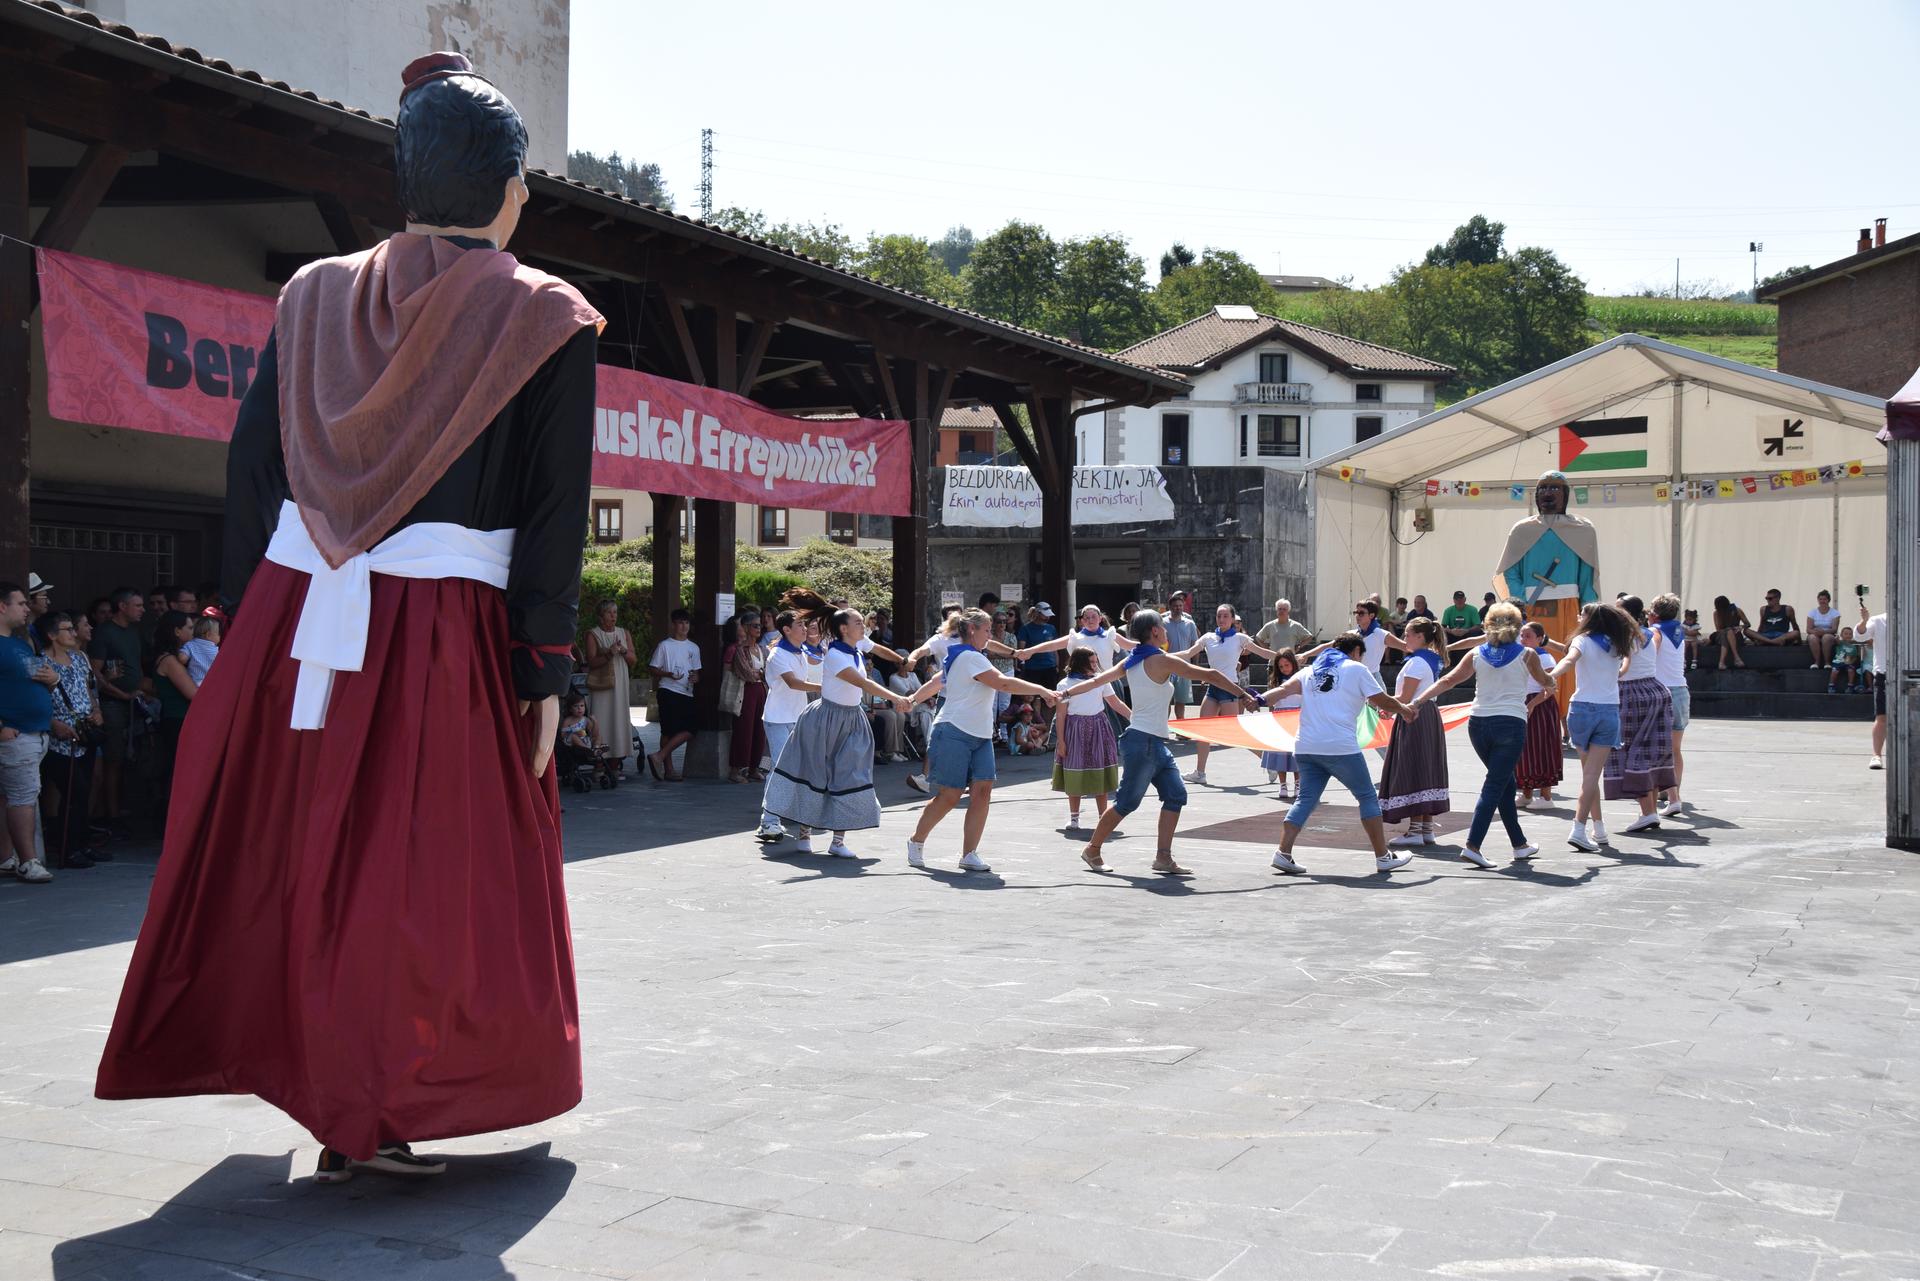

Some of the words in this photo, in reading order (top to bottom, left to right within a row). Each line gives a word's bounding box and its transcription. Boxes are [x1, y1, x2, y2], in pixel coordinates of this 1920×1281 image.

[145, 312, 256, 400] Ber
[593, 399, 696, 465] uskal
[700, 413, 878, 491] Errepublika!
[984, 492, 1043, 510] autodefent
